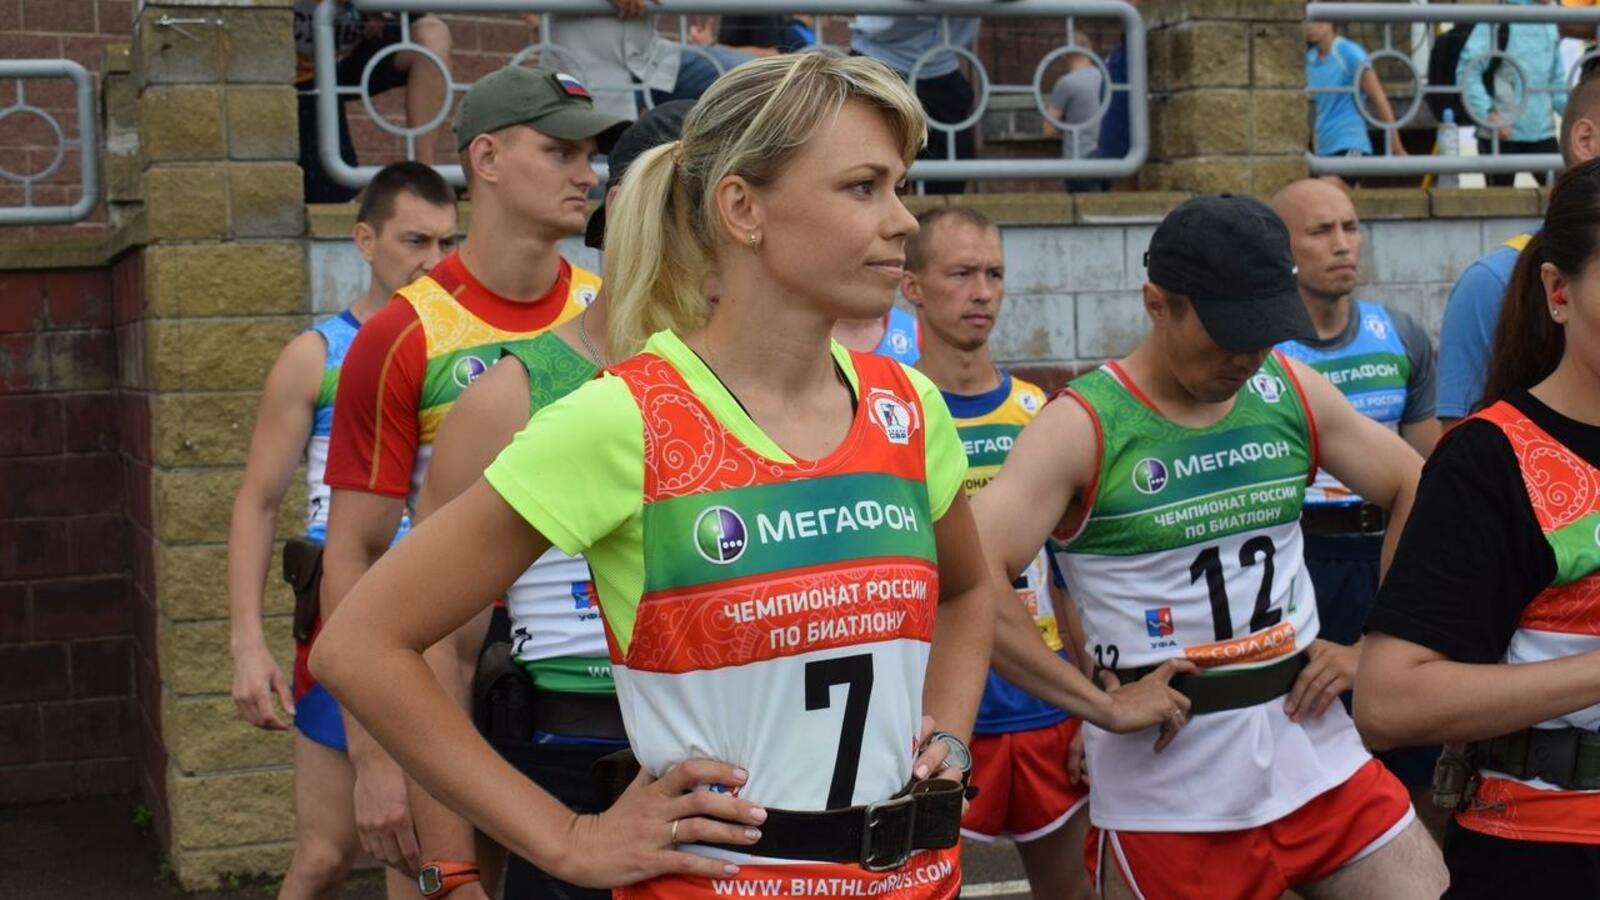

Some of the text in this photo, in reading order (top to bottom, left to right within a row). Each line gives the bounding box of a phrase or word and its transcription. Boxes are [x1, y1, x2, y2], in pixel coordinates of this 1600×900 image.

[963, 436, 1013, 455] ЕГАФ
[1154, 485, 1298, 527] ЧЕМПИОНАТ РОССИИ
[1185, 507, 1282, 540] ПО БИАТЛОНУ
[723, 578, 927, 624] ЧЕМПИОНАТ РОССИИ
[1189, 535, 1282, 641] 12
[770, 610, 906, 649] ПО БИАТЛОНУ
[1150, 641, 1177, 650] УФА
[805, 653, 874, 811] 7
[712, 860, 952, 897] WWW.BIATHLONRUS.COM
